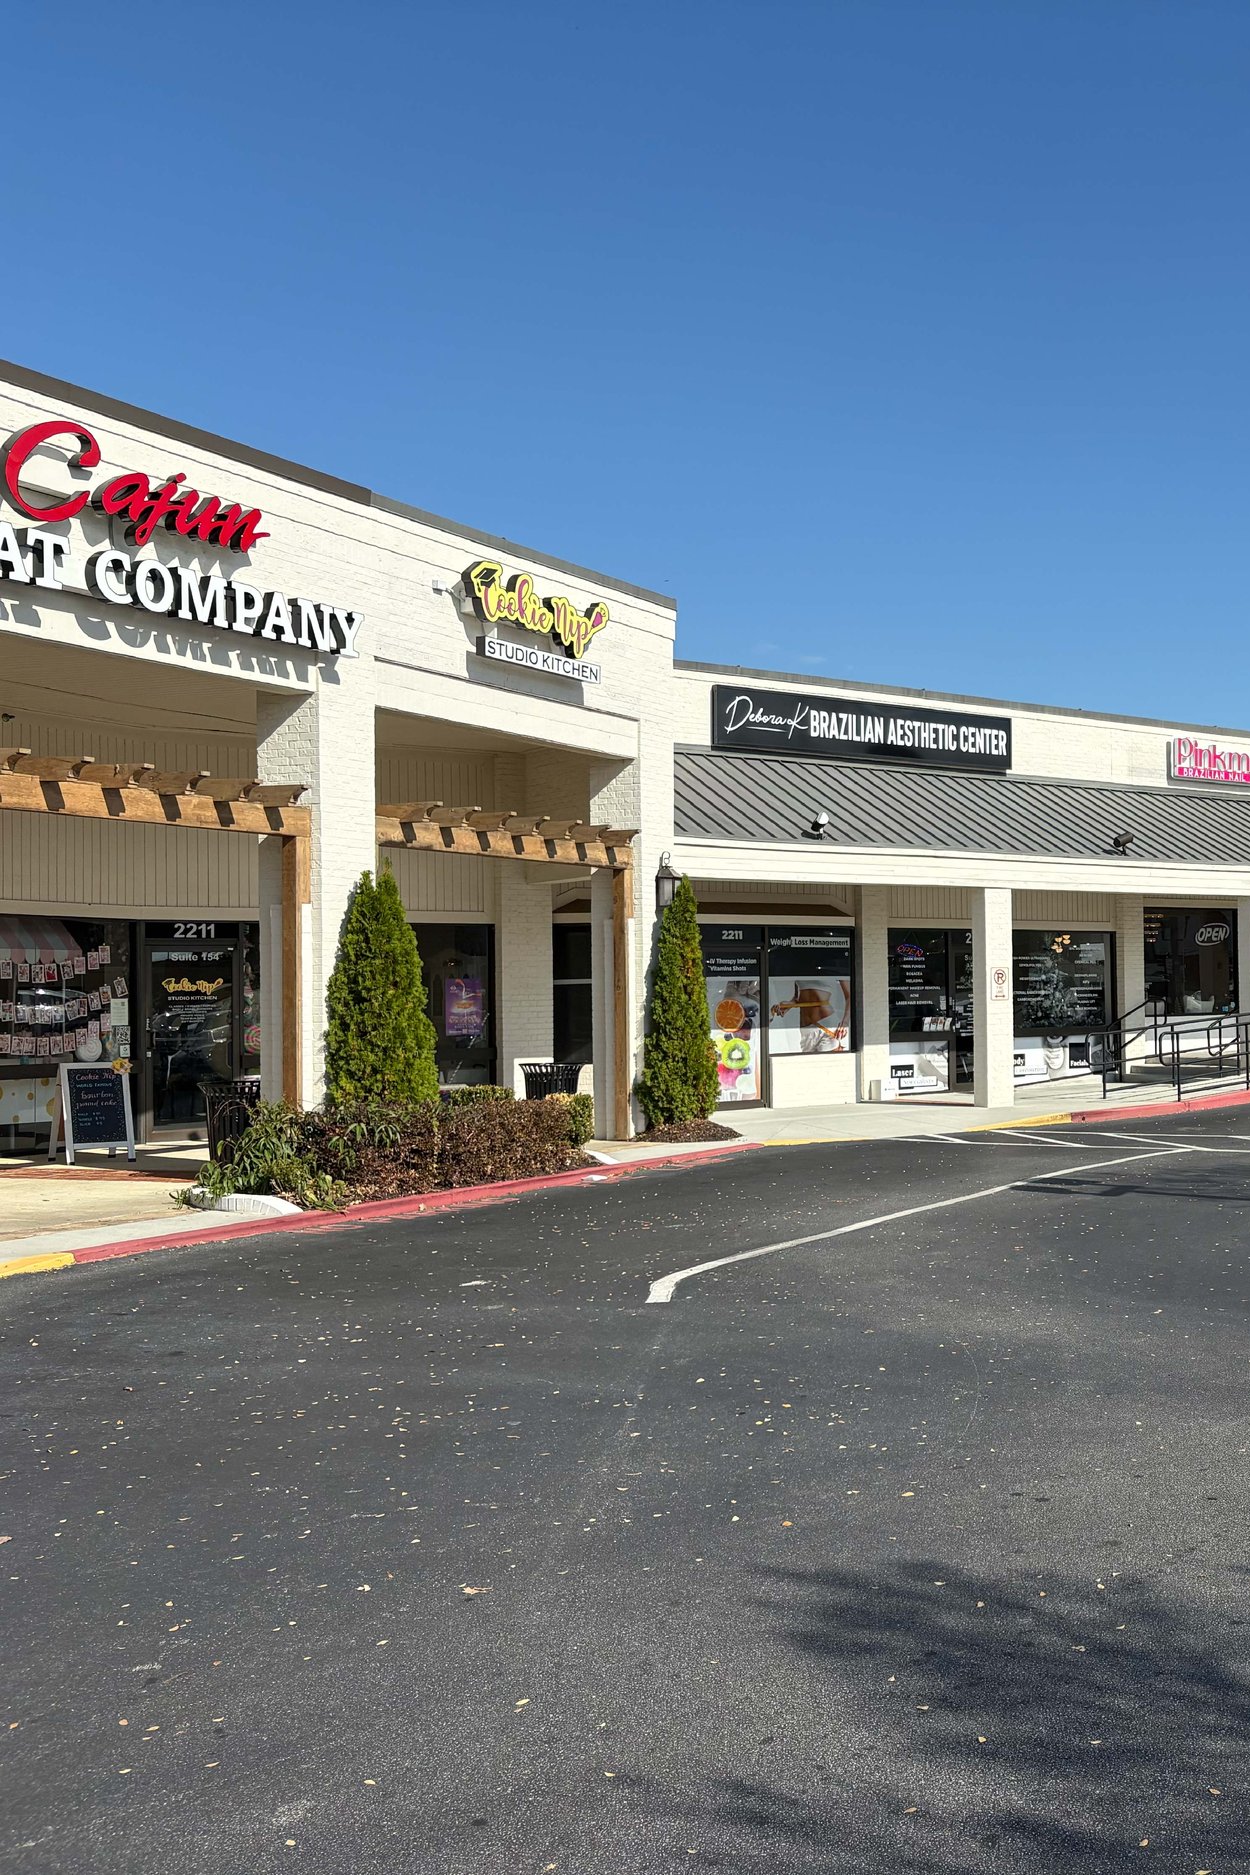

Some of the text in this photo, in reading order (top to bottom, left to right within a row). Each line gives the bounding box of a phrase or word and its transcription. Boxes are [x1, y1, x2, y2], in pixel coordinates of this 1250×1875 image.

[3, 420, 271, 553] Cajun
[94, 548, 366, 659] COMPANY
[474, 568, 597, 655] Cookie Nip
[487, 640, 599, 682] STUDIO KITCHEN
[724, 695, 787, 733] Debora
[809, 710, 884, 744] BRAZILIAN
[887, 717, 957, 751] AESTHETIC
[959, 724, 1007, 756] CENTER
[1183, 767, 1226, 779] BRAZILIAN
[1229, 772, 1246, 782] NAIL
[173, 922, 216, 939] 2211
[721, 930, 743, 940] 2211
[1197, 927, 1227, 942] OPEN
[809, 938, 849, 947] Management
[171, 952, 198, 962] Suite
[897, 945, 924, 957] OPEN
[75, 1073, 100, 1081] Cookie
[892, 1068, 914, 1077] Laser
